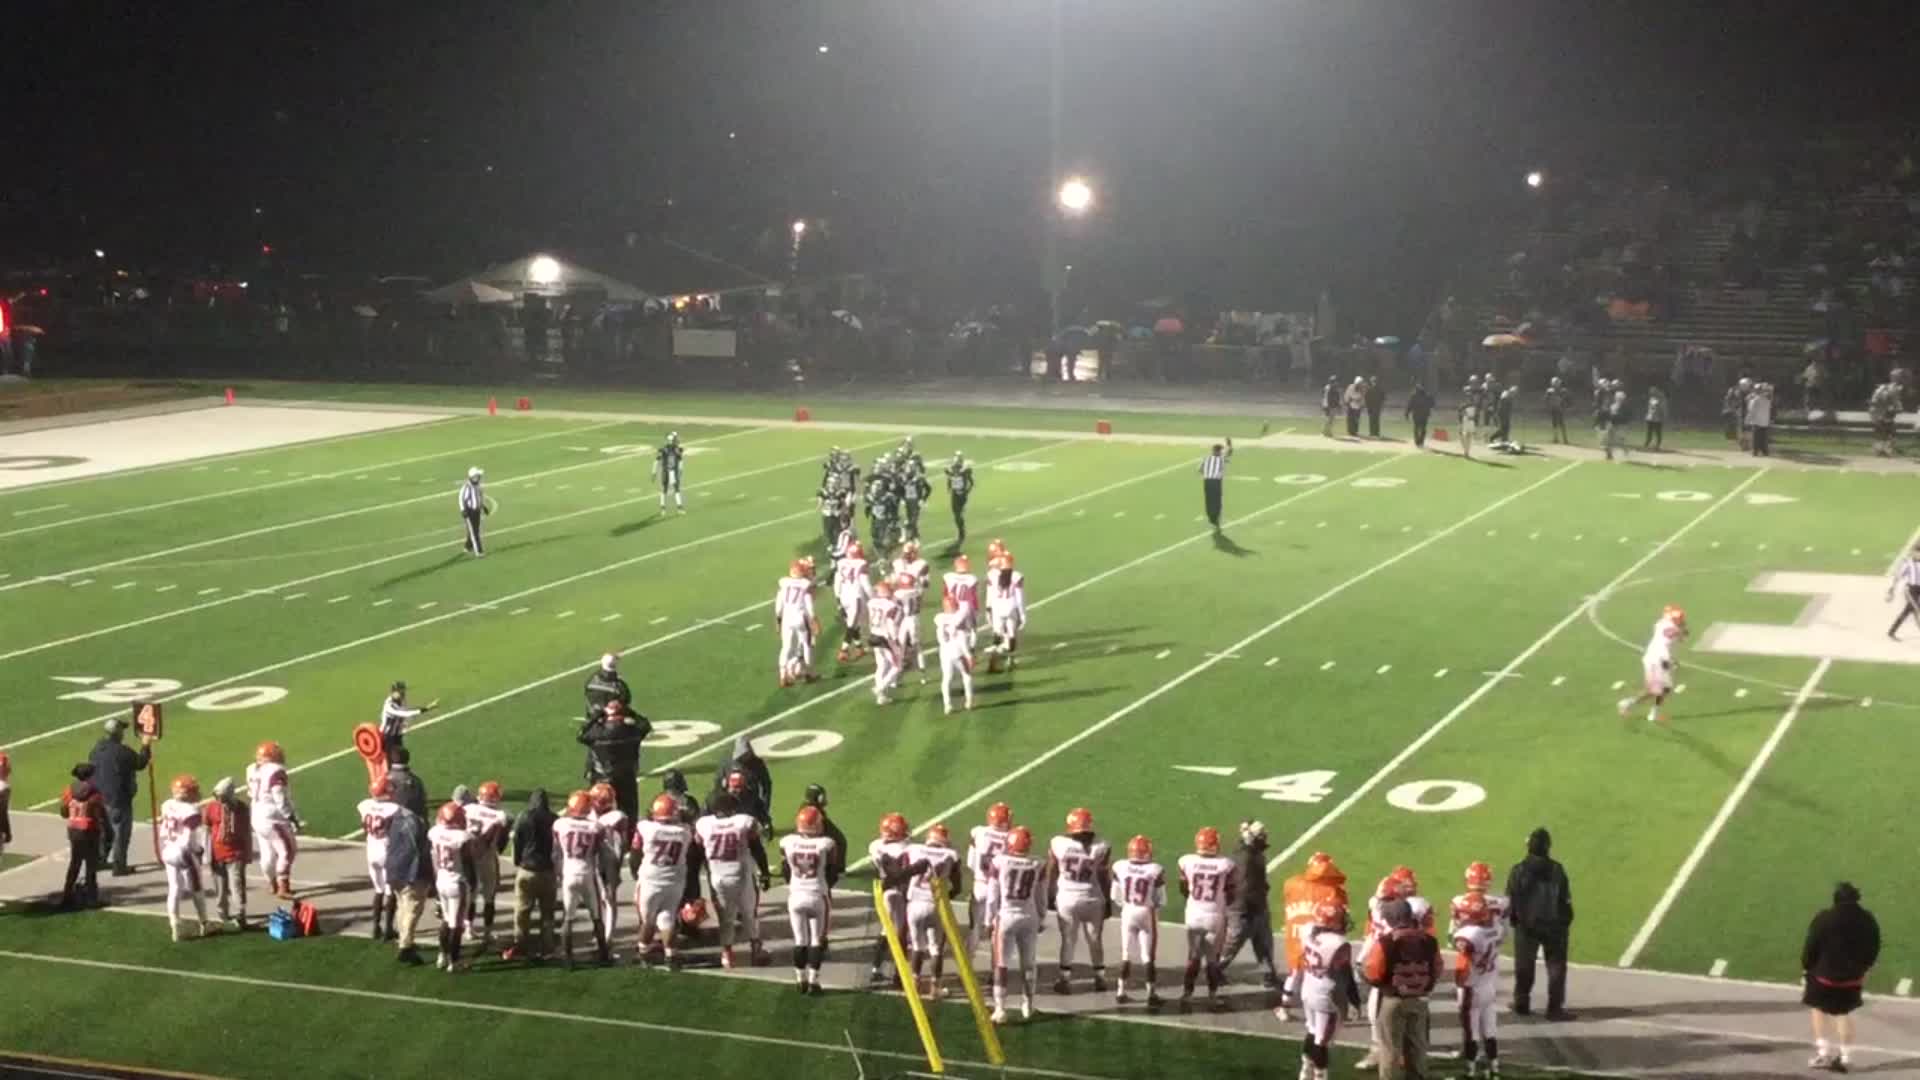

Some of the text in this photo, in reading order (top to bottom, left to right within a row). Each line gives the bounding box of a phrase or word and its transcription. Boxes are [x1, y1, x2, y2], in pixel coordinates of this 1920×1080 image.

[136, 703, 156, 735] 4
[1238, 769, 1488, 812] 40
[1124, 875, 1151, 907] 19
[1192, 872, 1221, 903] 63
